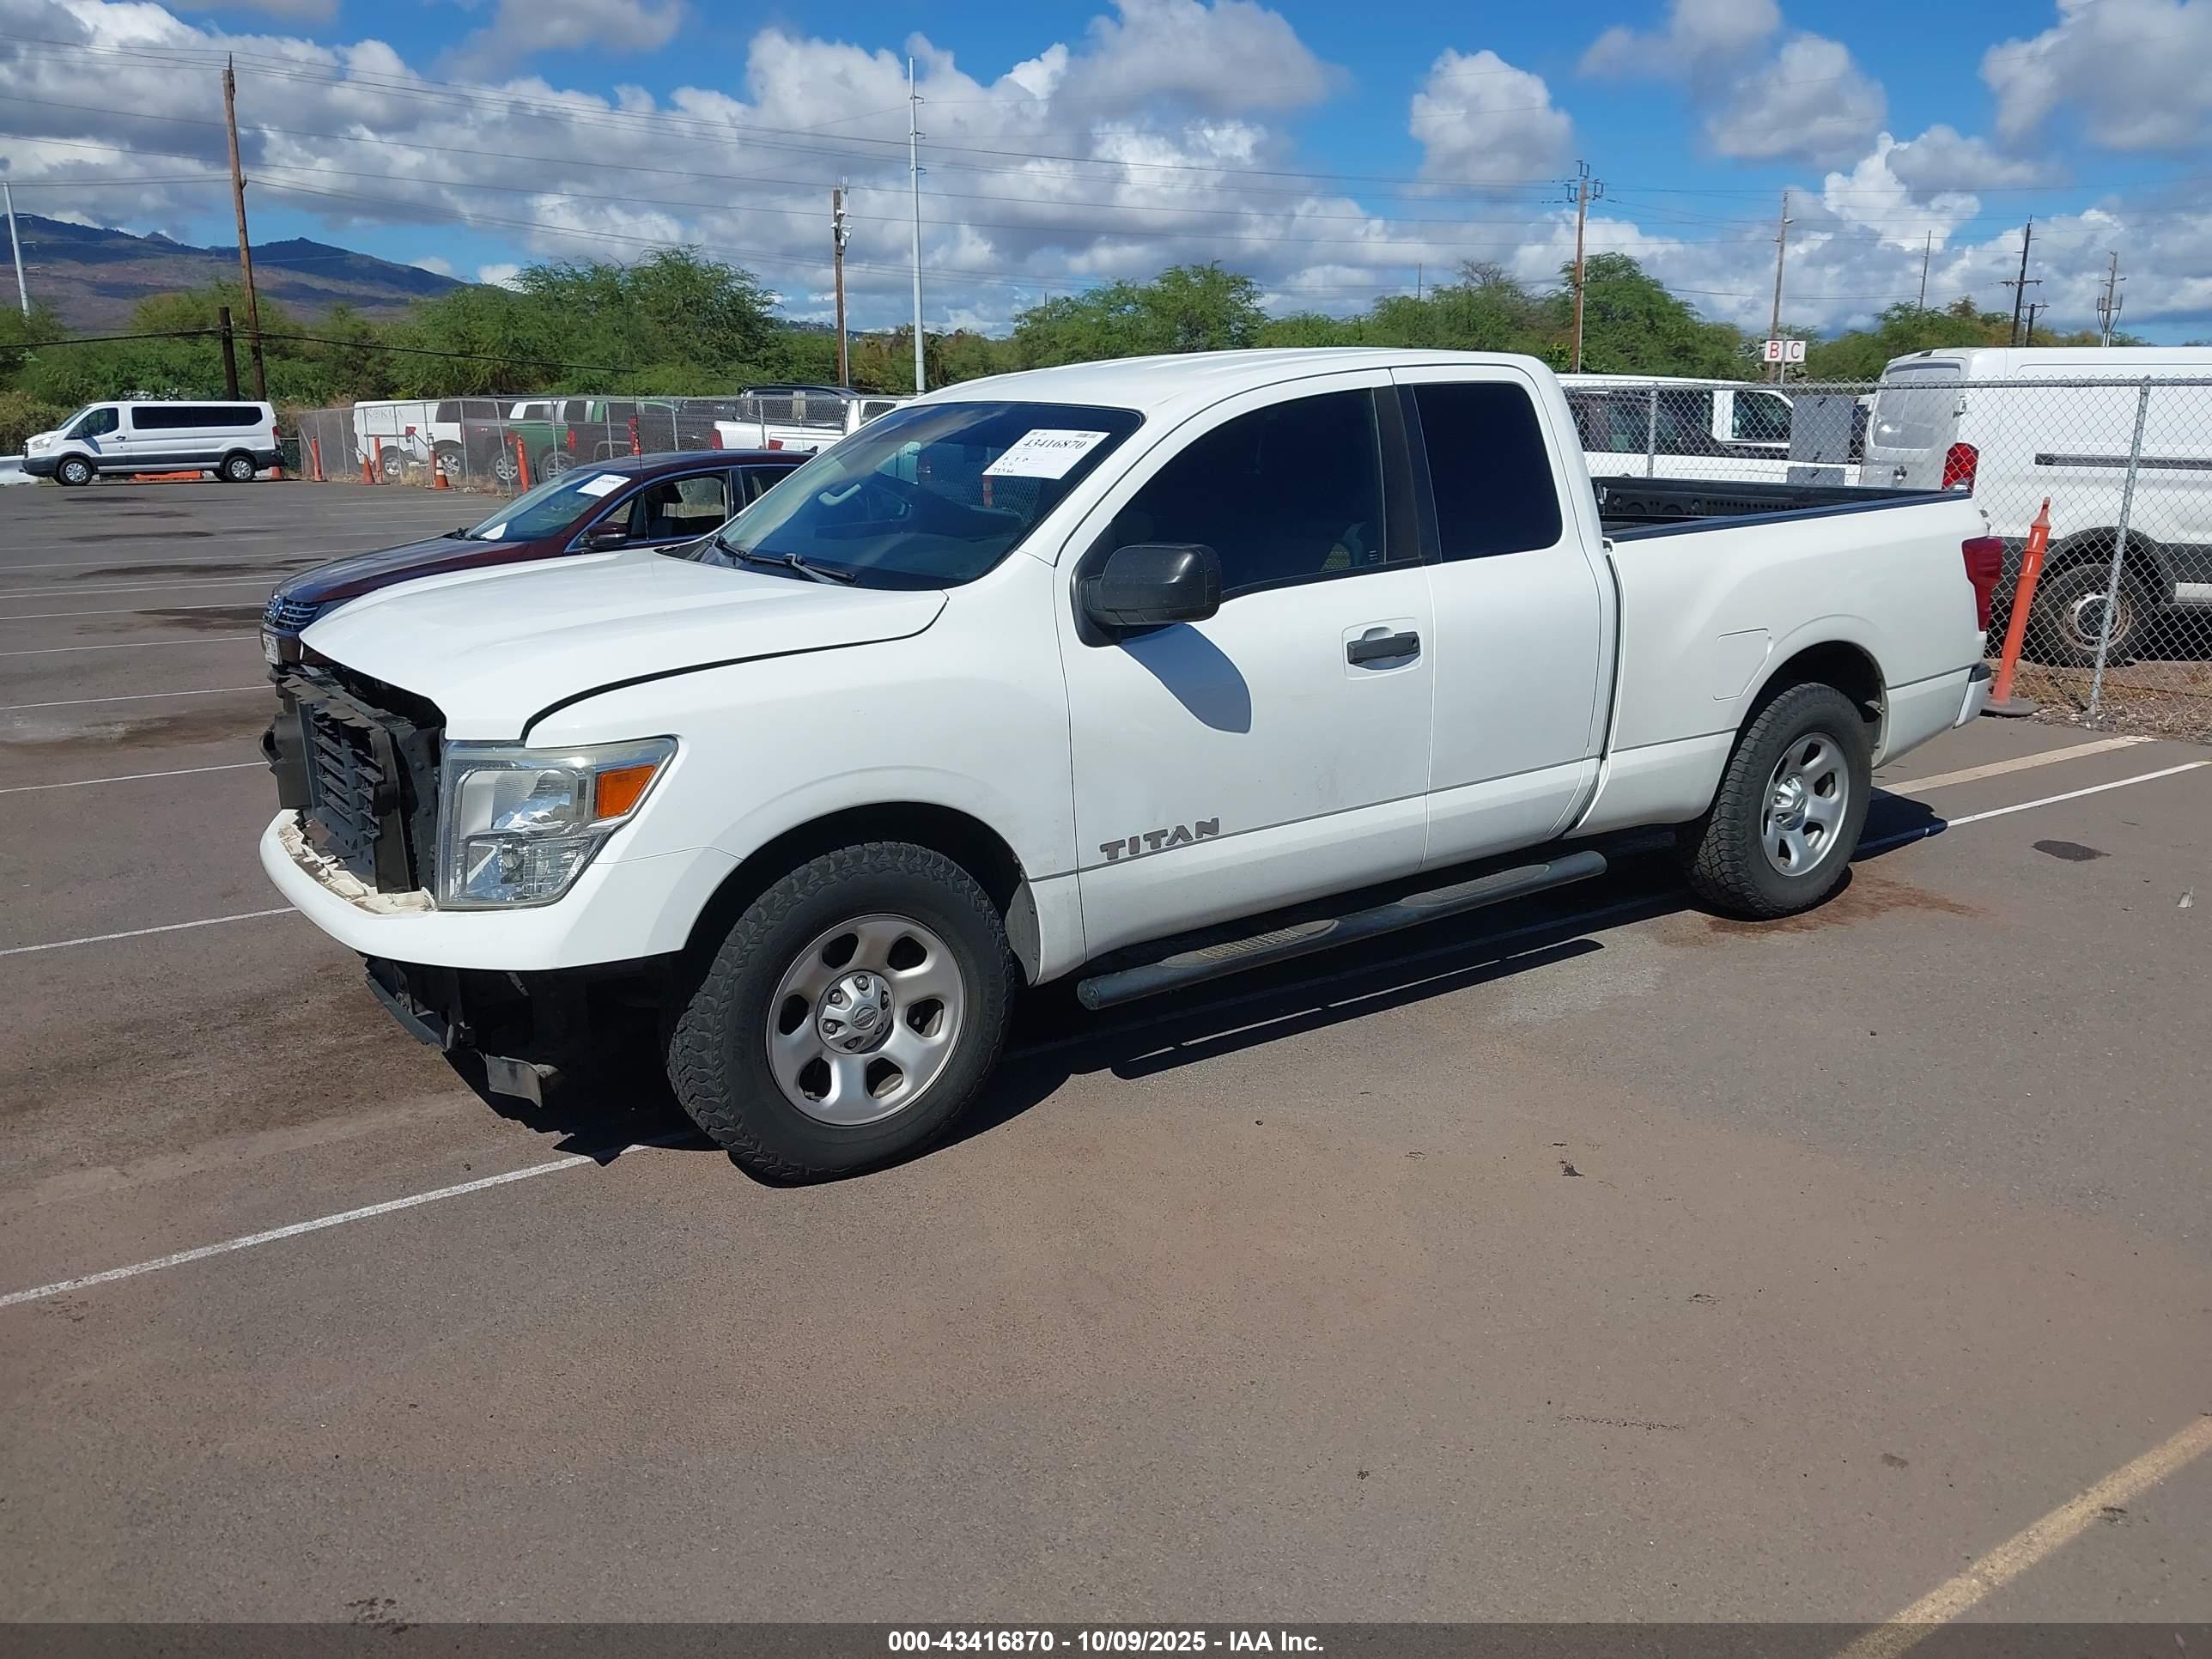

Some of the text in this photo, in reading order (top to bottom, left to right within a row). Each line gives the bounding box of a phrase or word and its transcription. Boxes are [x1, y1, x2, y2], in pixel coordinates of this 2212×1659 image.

[1770, 342, 1779, 359] B
[1790, 342, 1801, 359] C
[1023, 438, 1088, 450] 43416870
[1099, 817, 1220, 861] TITAN
